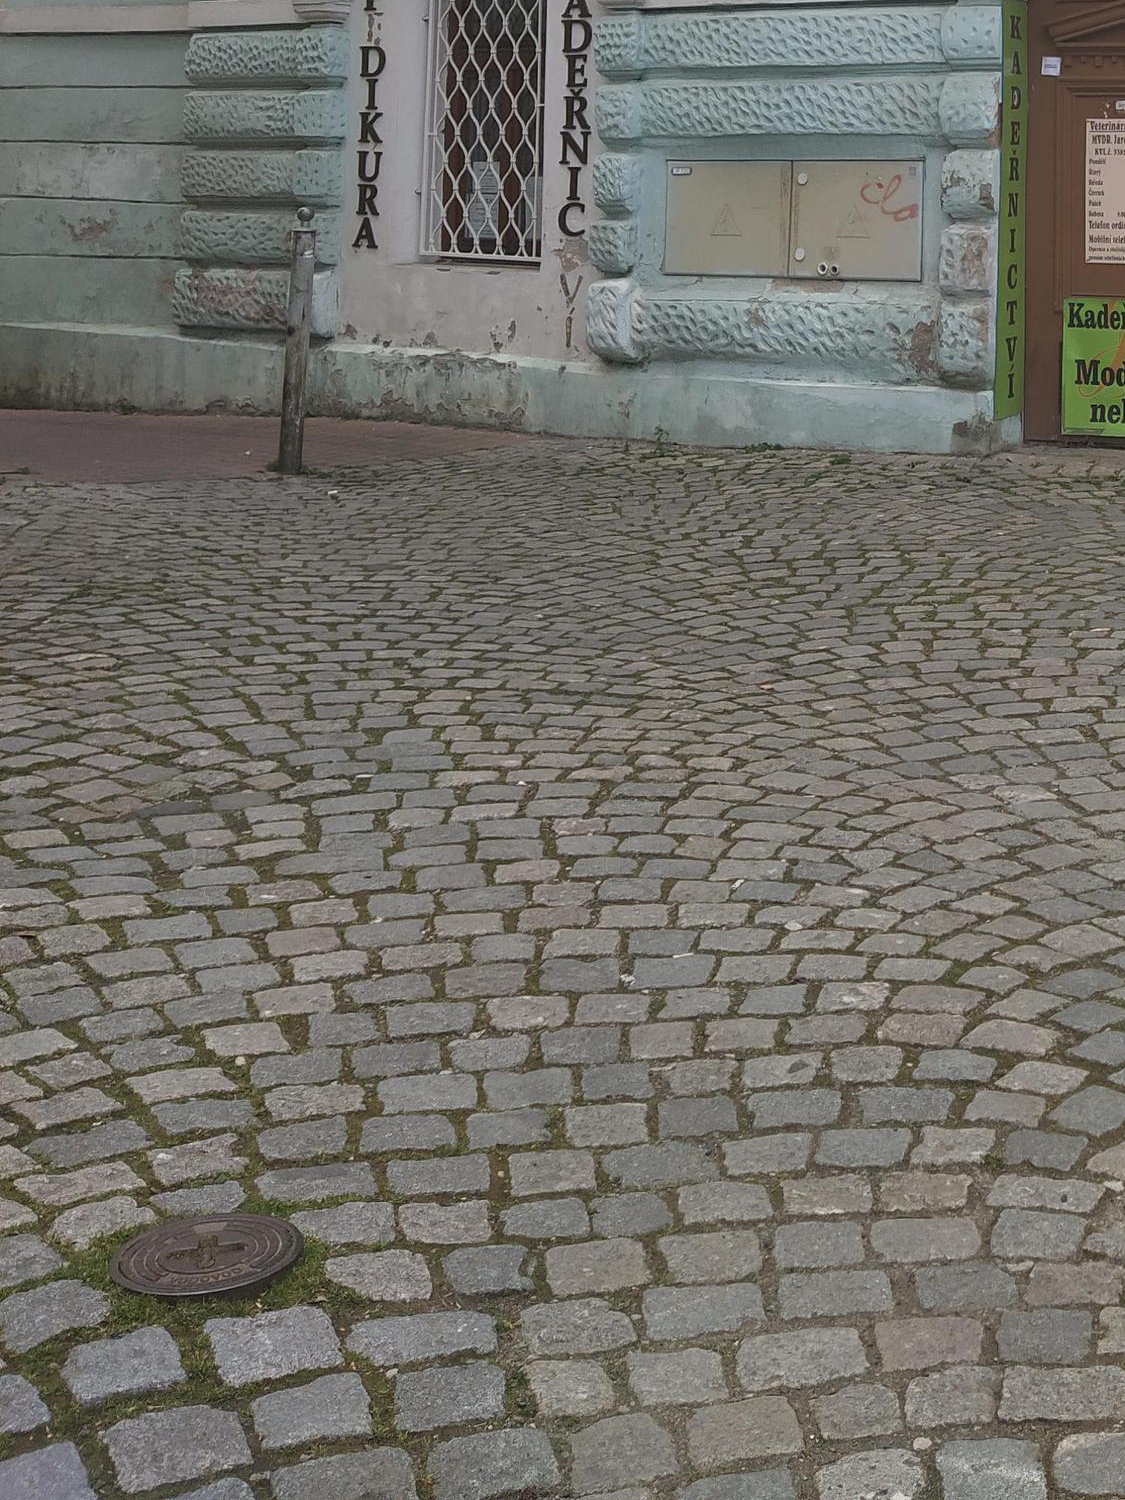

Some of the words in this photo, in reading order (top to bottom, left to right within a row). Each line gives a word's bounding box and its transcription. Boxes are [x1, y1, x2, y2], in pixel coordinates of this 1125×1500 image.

[1007, 15, 1022, 399] KADEŘNICTVÍ
[1088, 220, 1110, 230] Telefon
[1088, 234, 1111, 244] Mobilní
